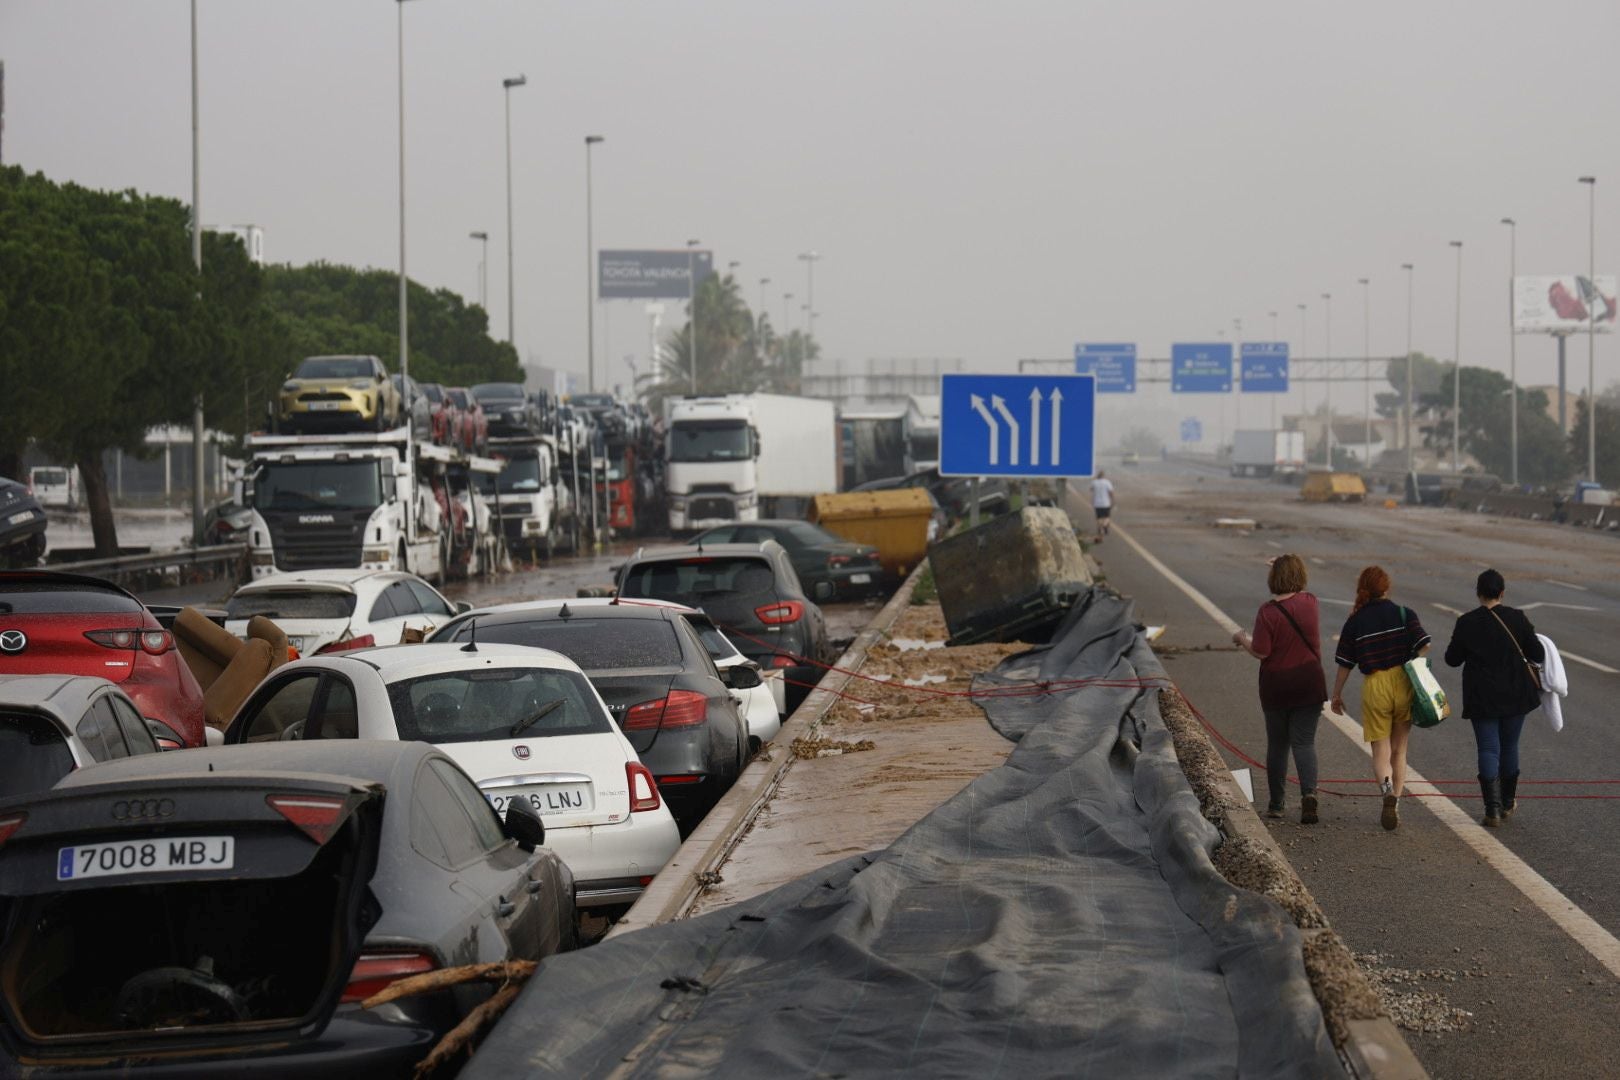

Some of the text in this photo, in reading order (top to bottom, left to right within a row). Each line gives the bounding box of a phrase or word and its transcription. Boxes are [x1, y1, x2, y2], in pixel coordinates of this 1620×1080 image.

[298, 514, 334, 523] SCANIA
[494, 794, 542, 813] 26
[546, 790, 582, 809] LNJ
[80, 841, 227, 873] 7008 MBJ
